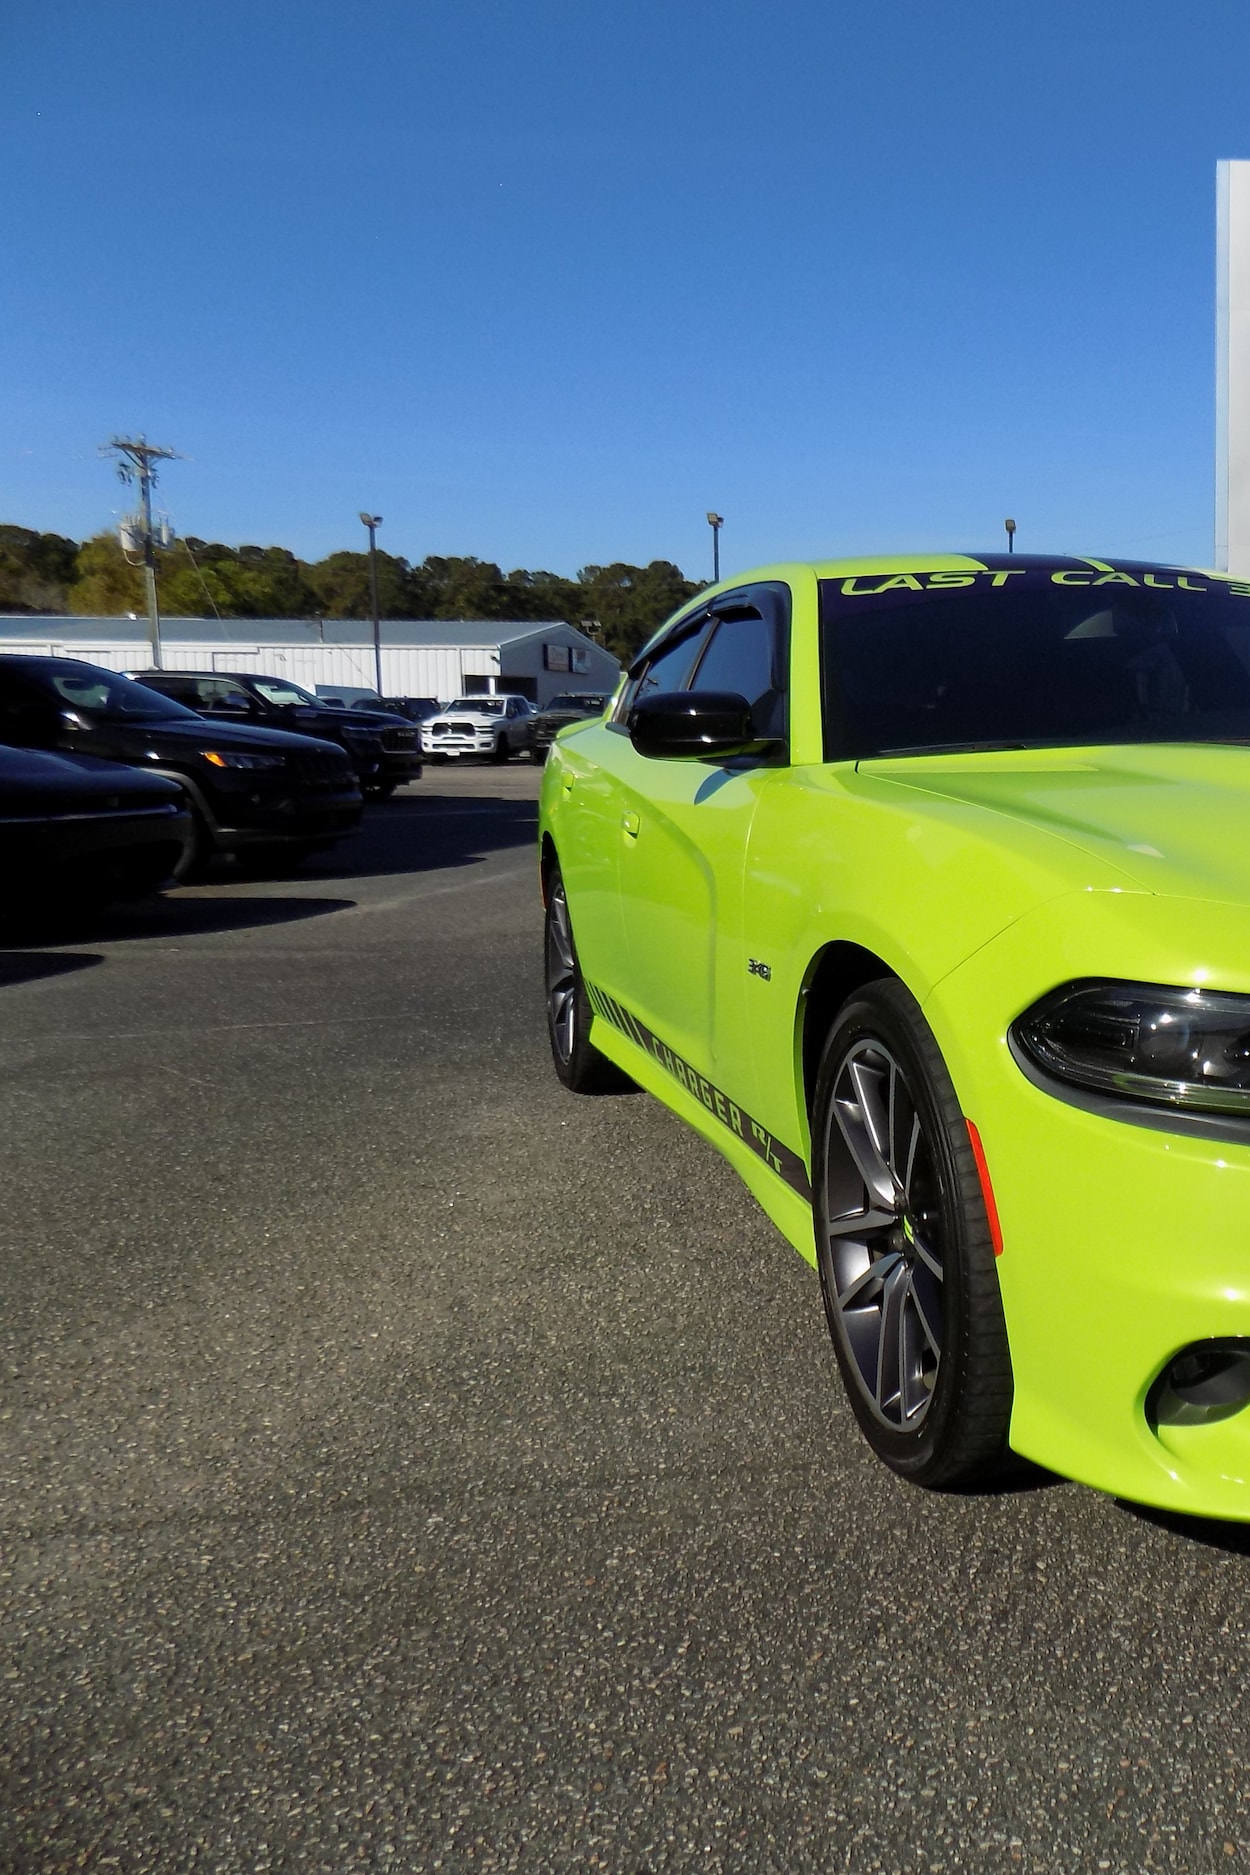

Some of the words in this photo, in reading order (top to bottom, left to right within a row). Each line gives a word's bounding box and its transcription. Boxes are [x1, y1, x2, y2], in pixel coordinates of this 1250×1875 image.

[840, 570, 1026, 596] LAST
[1050, 570, 1207, 592] CALL
[652, 1036, 744, 1137] CHARGER
[751, 1121, 783, 1174] R/T
